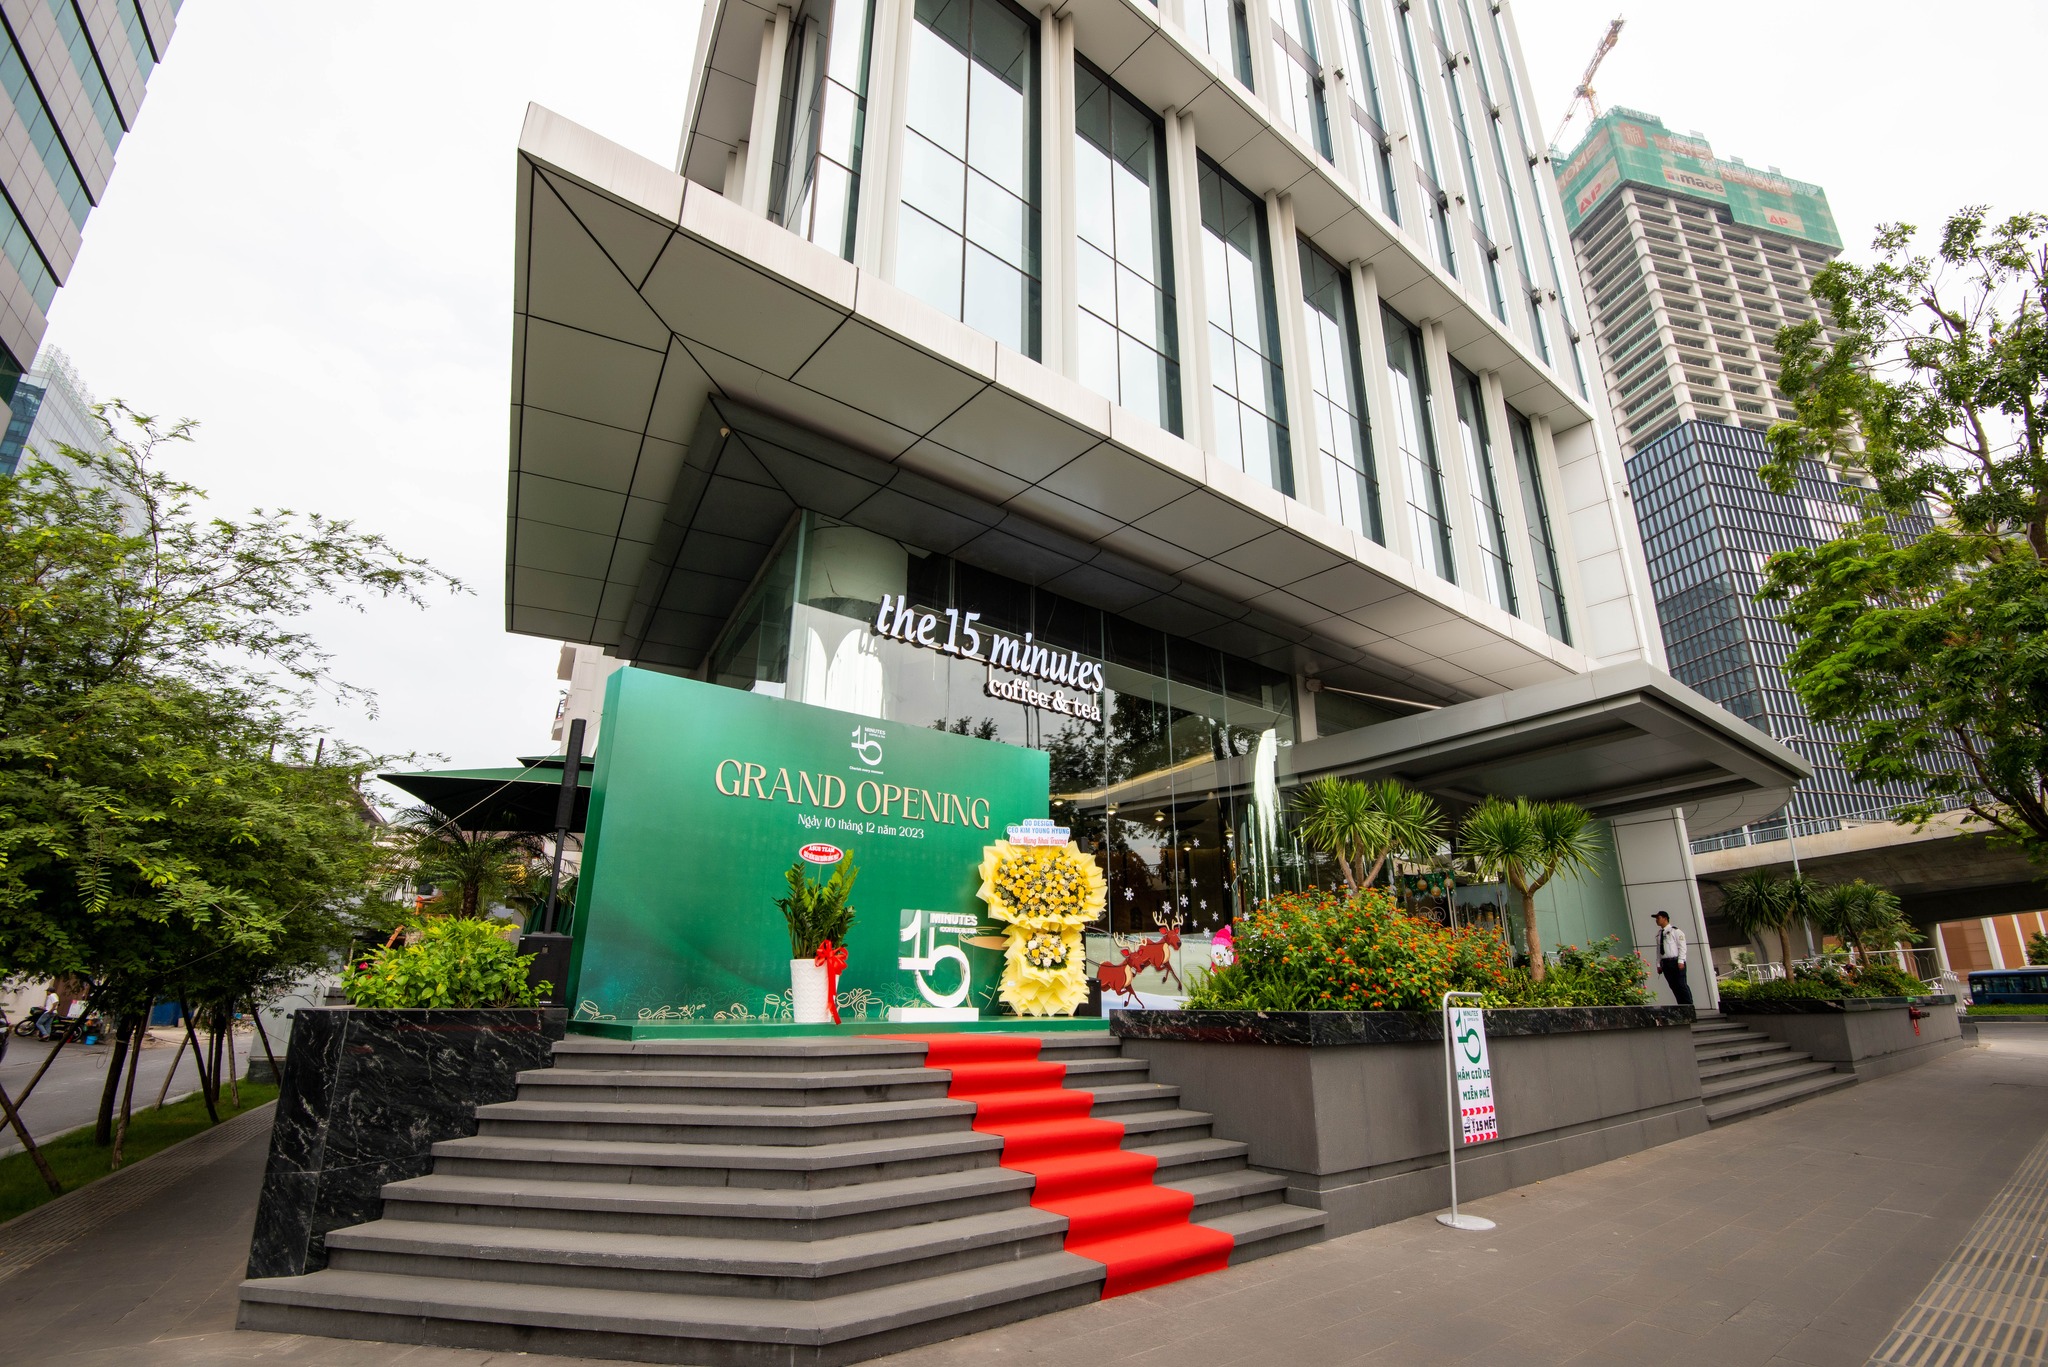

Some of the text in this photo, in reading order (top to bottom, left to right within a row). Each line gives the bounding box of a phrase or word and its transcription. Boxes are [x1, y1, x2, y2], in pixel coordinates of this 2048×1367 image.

[1680, 174, 1724, 193] mace
[1579, 182, 1602, 215] AP
[1769, 215, 1788, 226] AP
[876, 593, 1104, 693] the 15 minutes
[988, 678, 1102, 722] coffee & tea
[865, 727, 886, 735] MINUTES
[851, 724, 883, 766] 15
[715, 759, 991, 830] GRAND OPENING
[798, 813, 925, 839] Ngày 10 tháng 12 năm 2023
[929, 912, 978, 926] MINUTES
[899, 909, 971, 1008] 15
[1456, 1009, 1481, 1064] 15
[1482, 1069, 1490, 1078] XE
[1479, 1086, 1490, 1098] PHÍ
[1475, 1116, 1496, 1131] 15 MÉT
